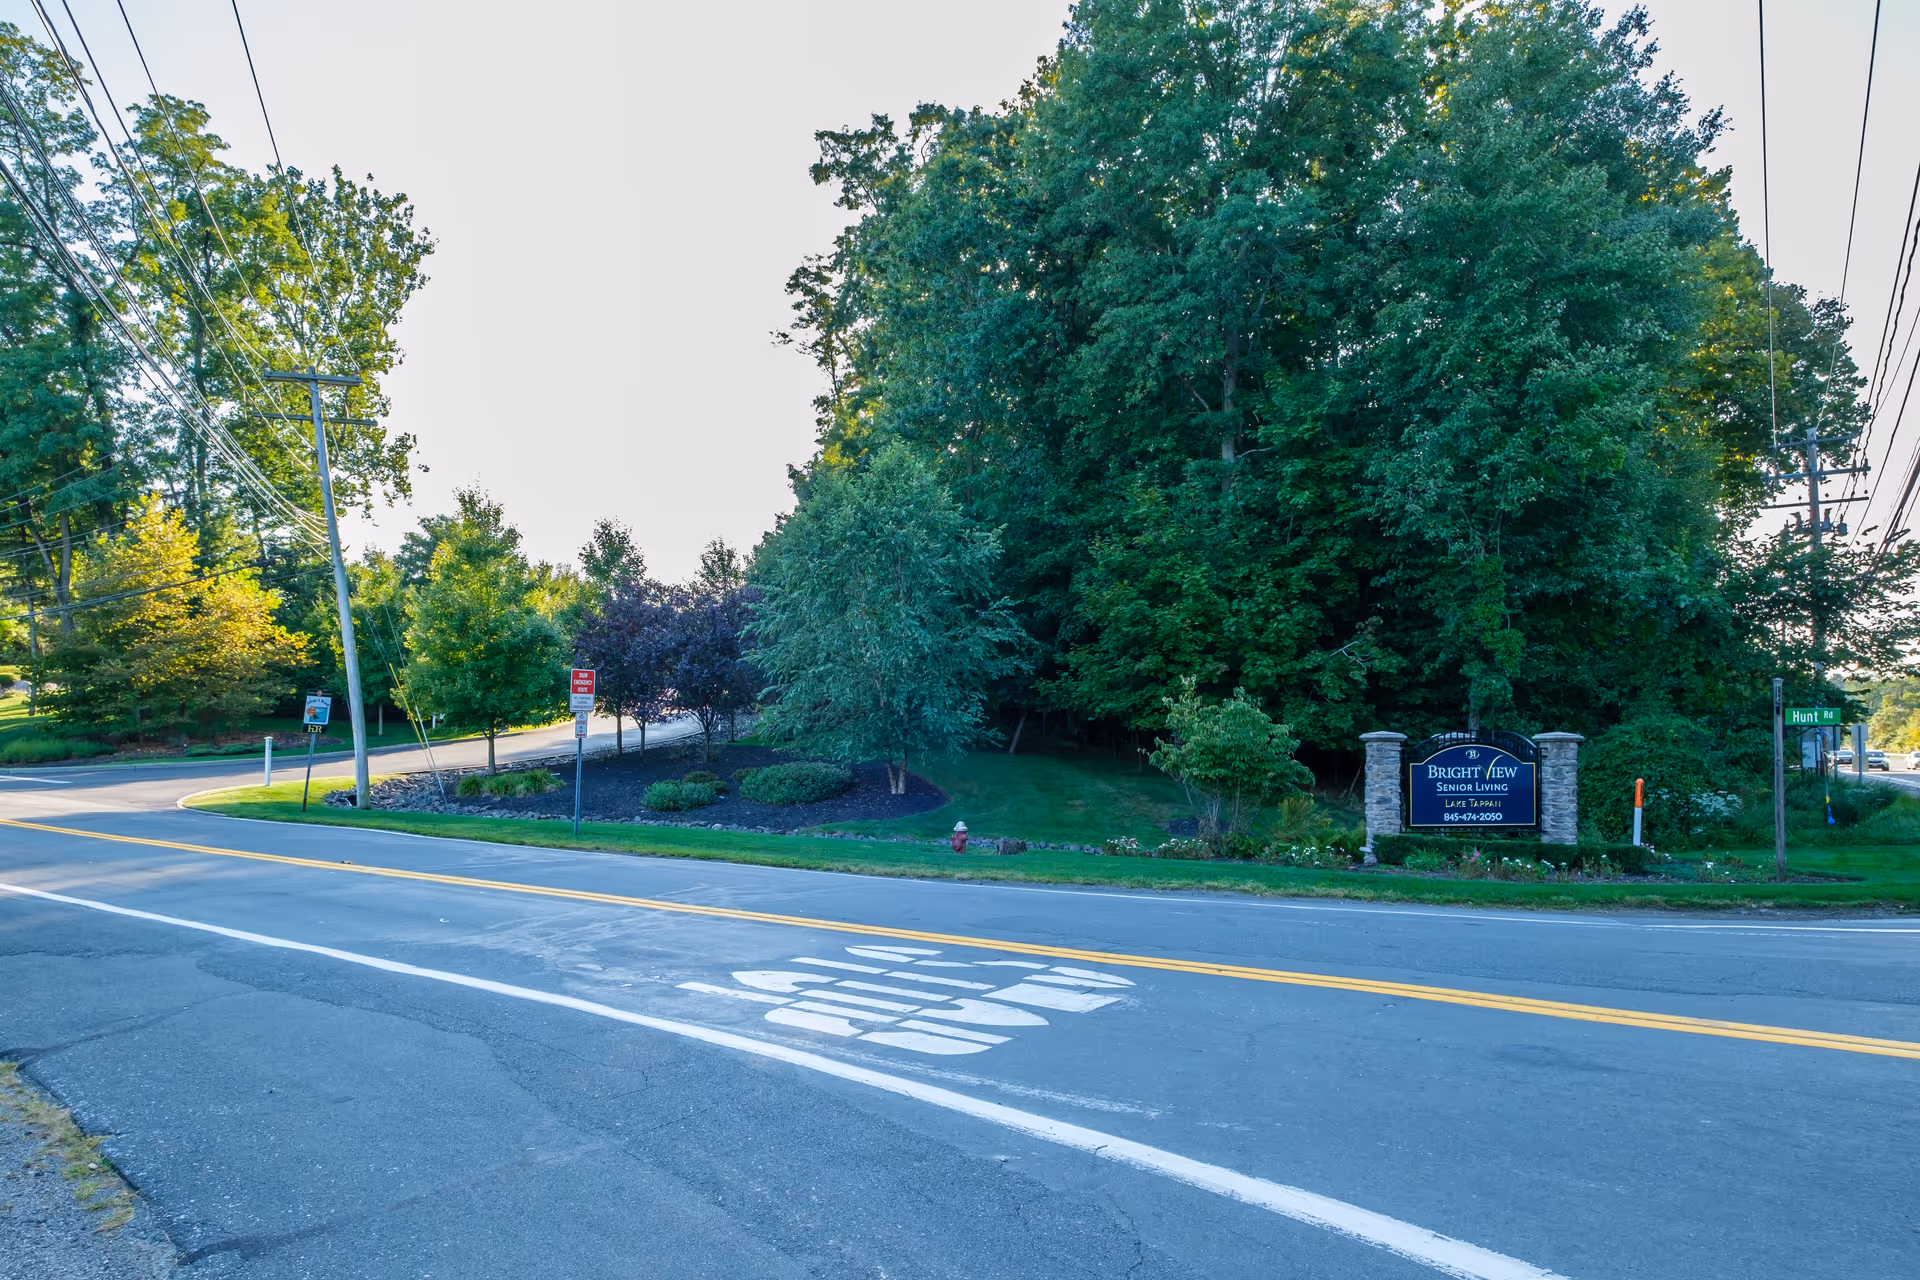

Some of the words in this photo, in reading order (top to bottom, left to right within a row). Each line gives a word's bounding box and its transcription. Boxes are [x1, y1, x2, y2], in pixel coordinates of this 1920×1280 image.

[1793, 711, 1818, 723] Hunt
[1824, 711, 1833, 719] Rd
[1469, 750, 1476, 758] 31
[1437, 782, 1472, 792] SENIOR
[1476, 782, 1508, 791] LIVING
[1445, 799, 1466, 808] LAKE
[1469, 799, 1501, 808] TAPPAN
[1444, 812, 1502, 822] 845-474-2050
[675, 945, 1137, 1055] STOP
